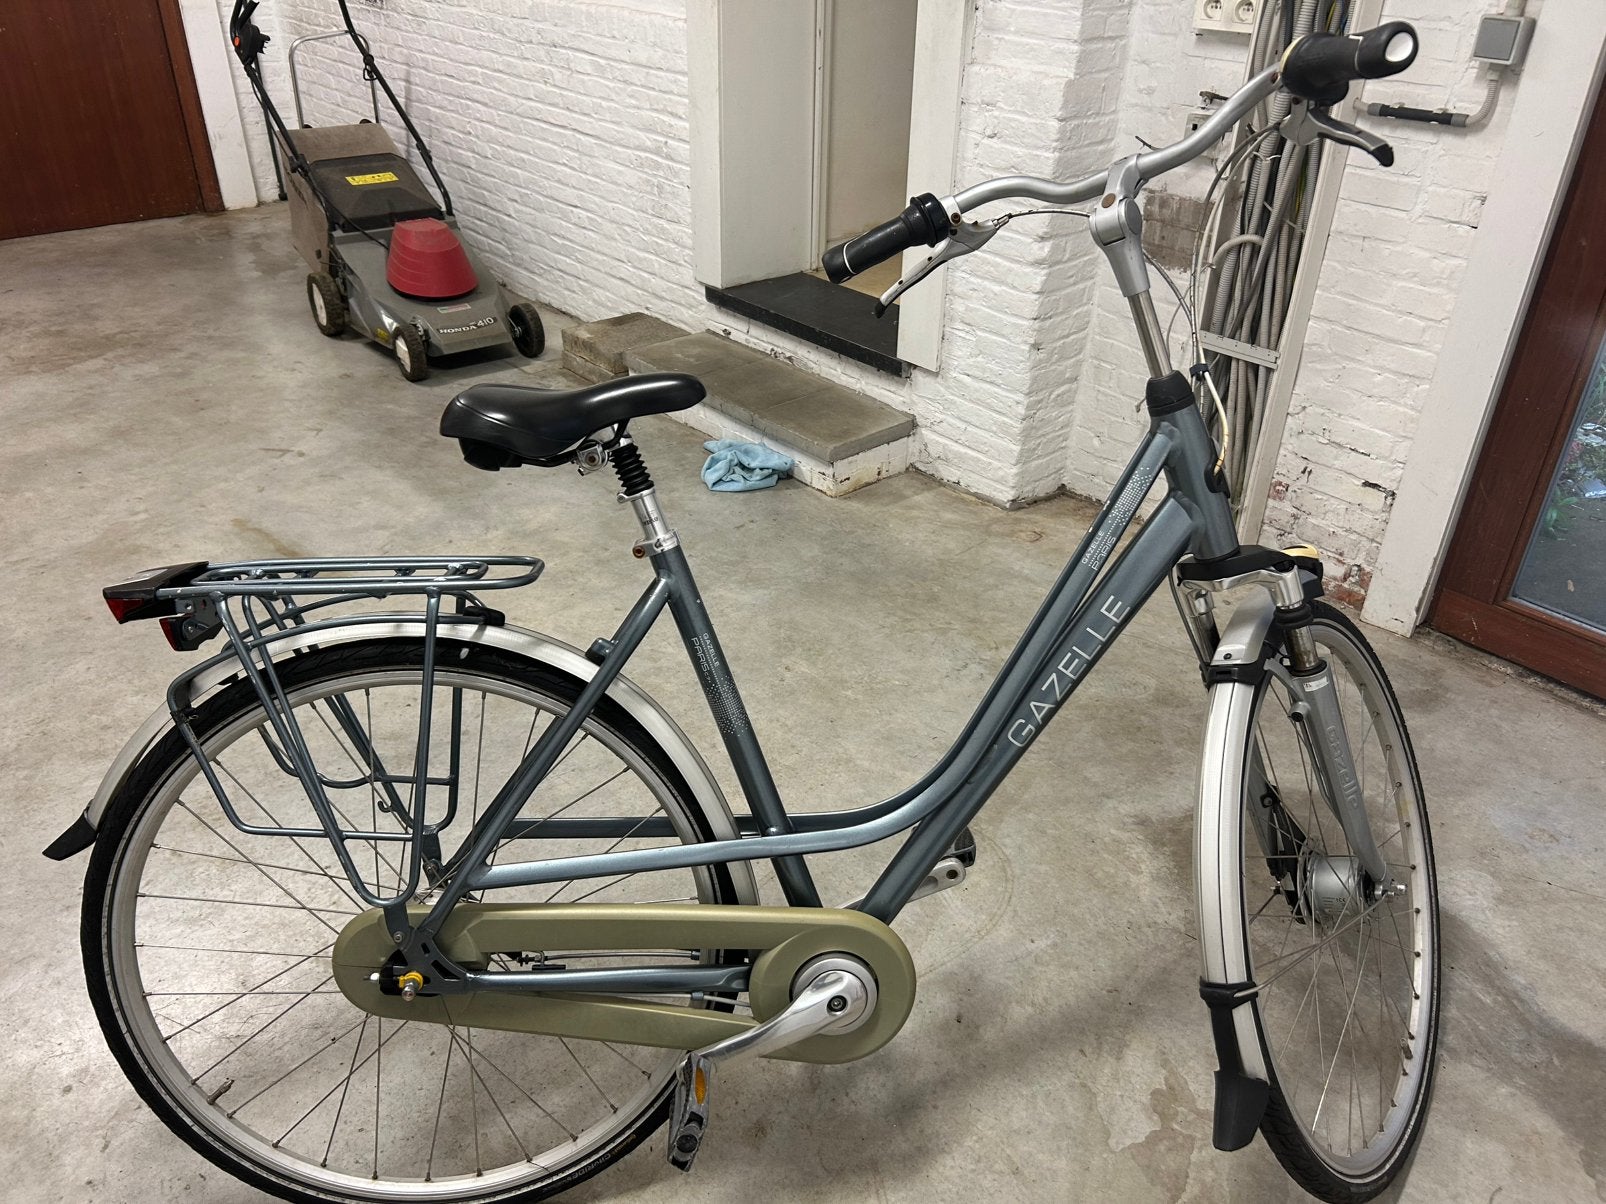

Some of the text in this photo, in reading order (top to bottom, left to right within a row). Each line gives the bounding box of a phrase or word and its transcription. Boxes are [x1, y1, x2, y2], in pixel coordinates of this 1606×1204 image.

[439, 325, 478, 334] HONDA
[477, 317, 494, 327] 410
[1081, 530, 1105, 564] GAZELLE
[1091, 536, 1117, 571] PARIS
[691, 637, 710, 672] PARIS
[702, 632, 720, 668] GAZELLE
[1007, 594, 1131, 748] GAZELLE
